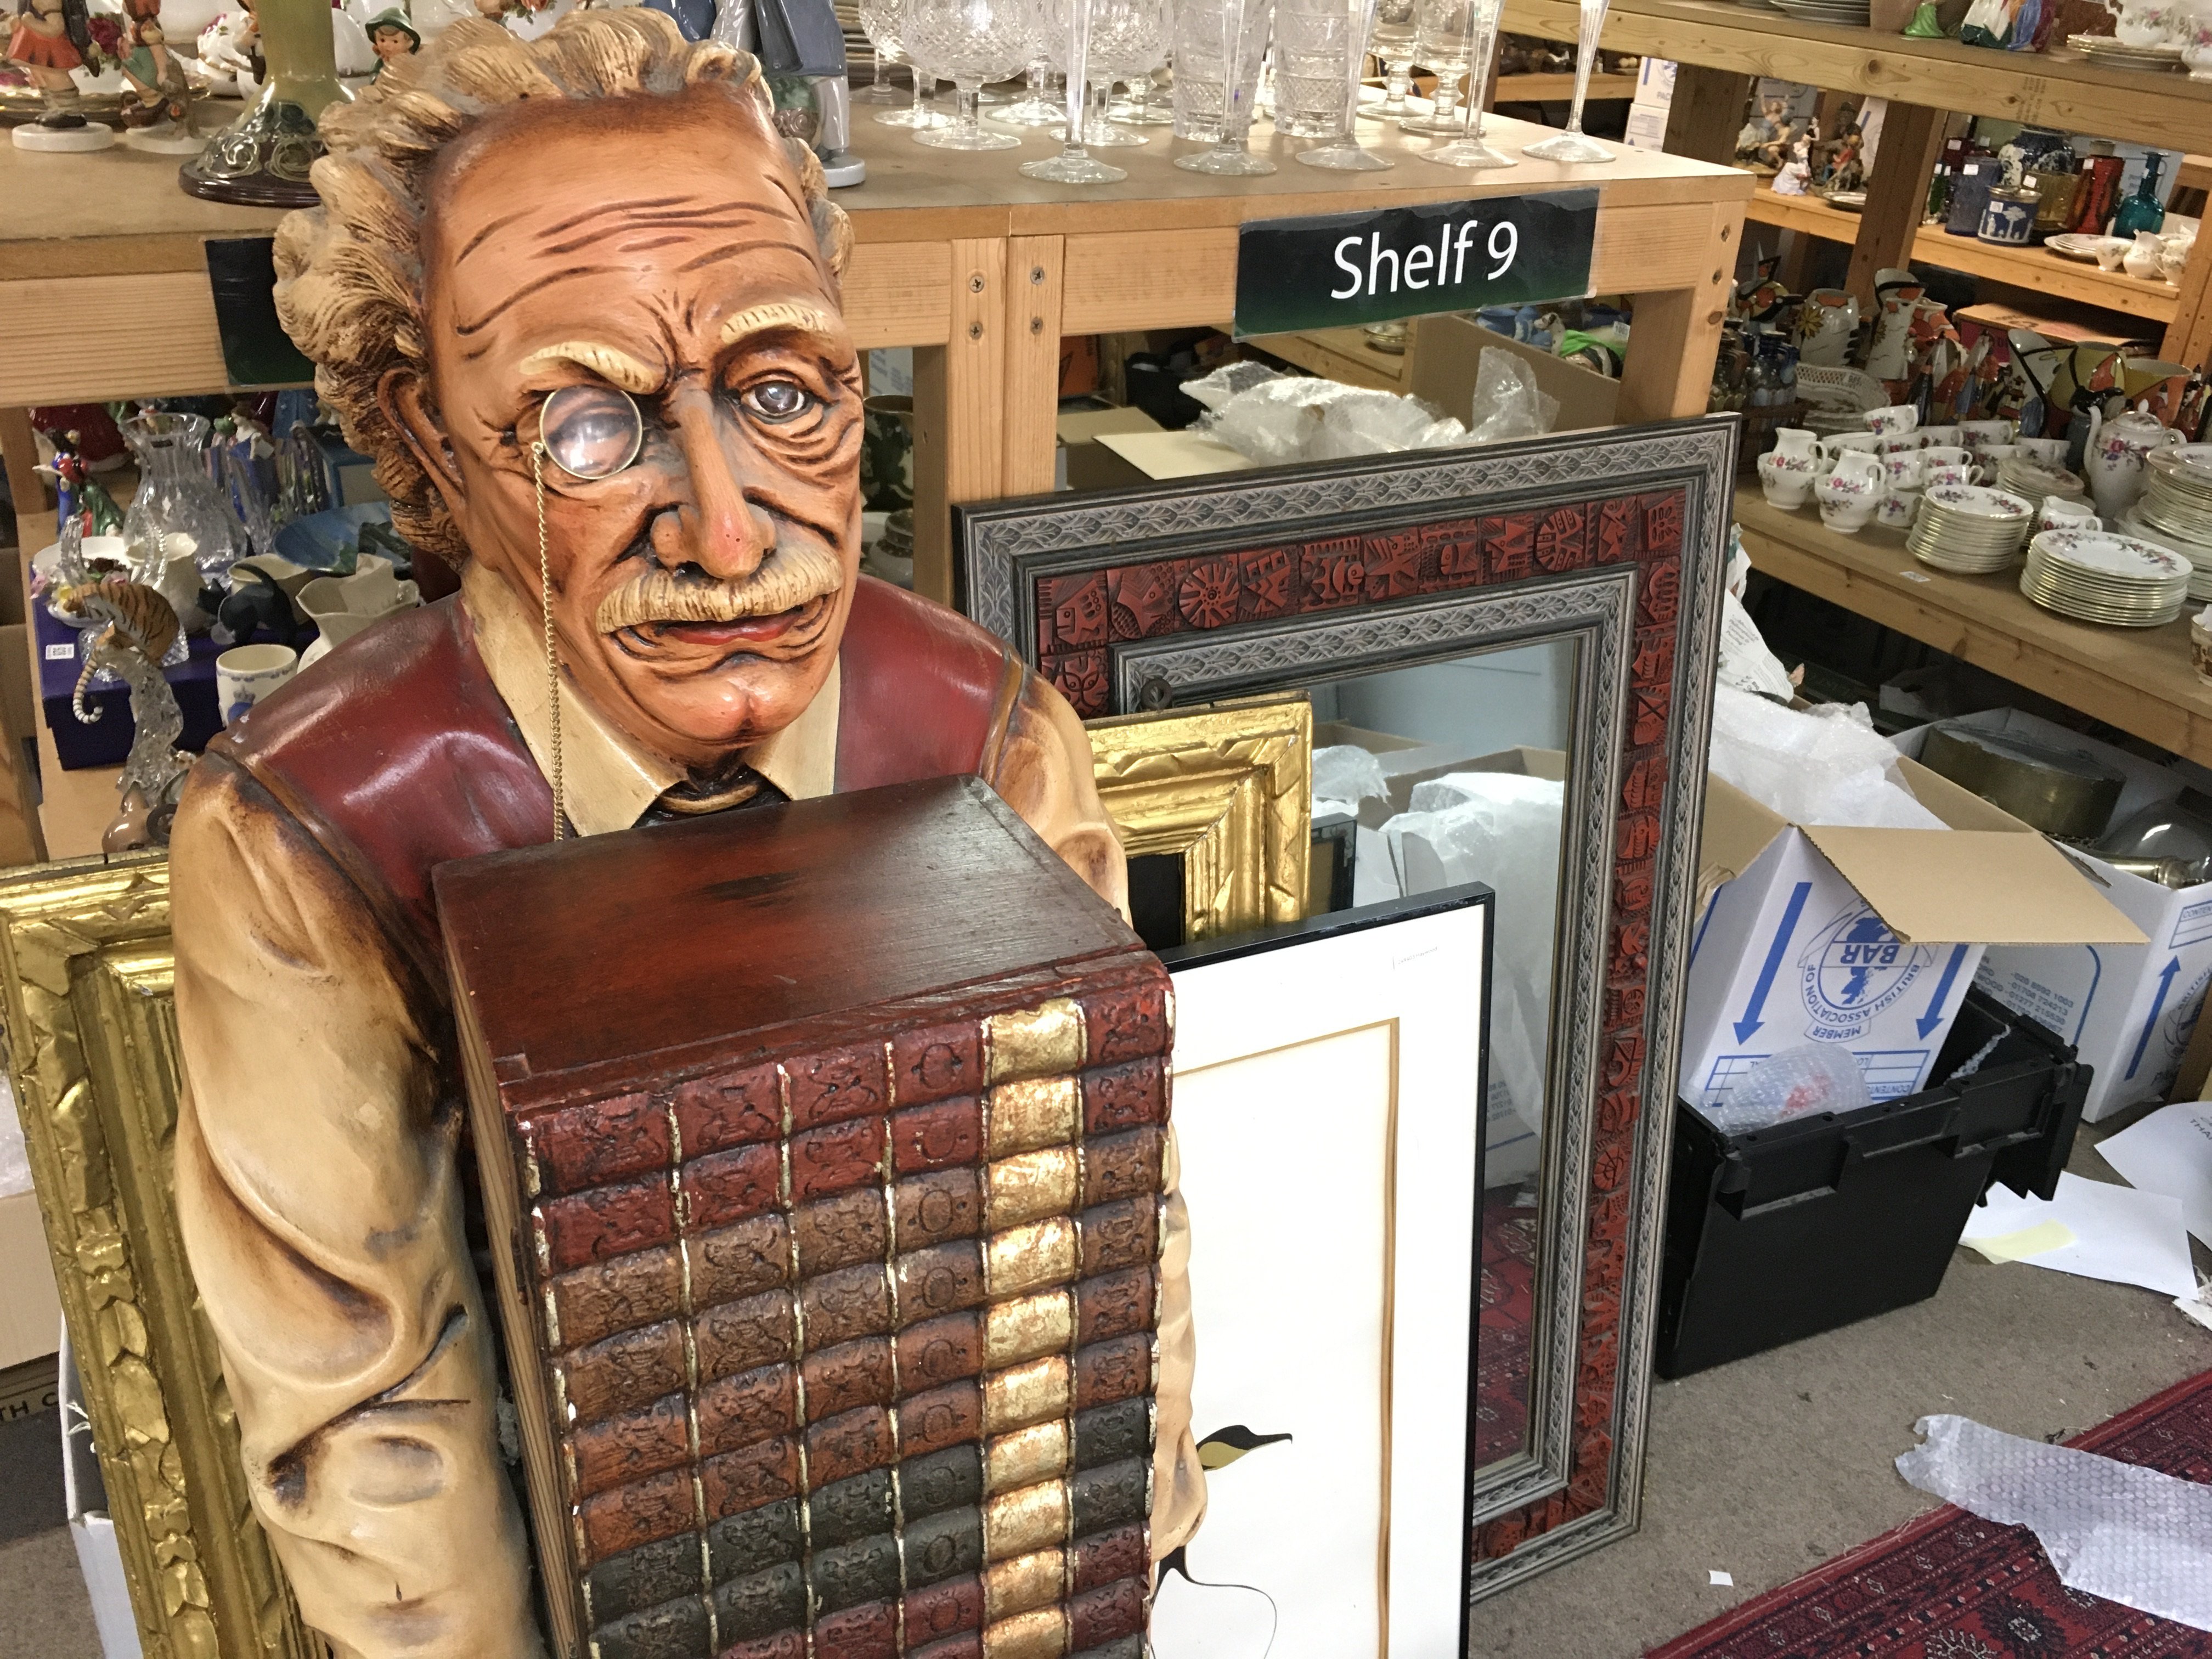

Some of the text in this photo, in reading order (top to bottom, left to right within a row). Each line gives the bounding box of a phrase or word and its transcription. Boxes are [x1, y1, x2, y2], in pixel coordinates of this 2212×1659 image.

[1330, 220, 1519, 299] Shelf 9
[1840, 945, 1900, 964] BAR
[1805, 964, 1920, 1024] BRITISH ASSOCIATION OF
[1813, 1025, 1861, 1039] MEMBER
[42, 1391, 59, 1407] C
